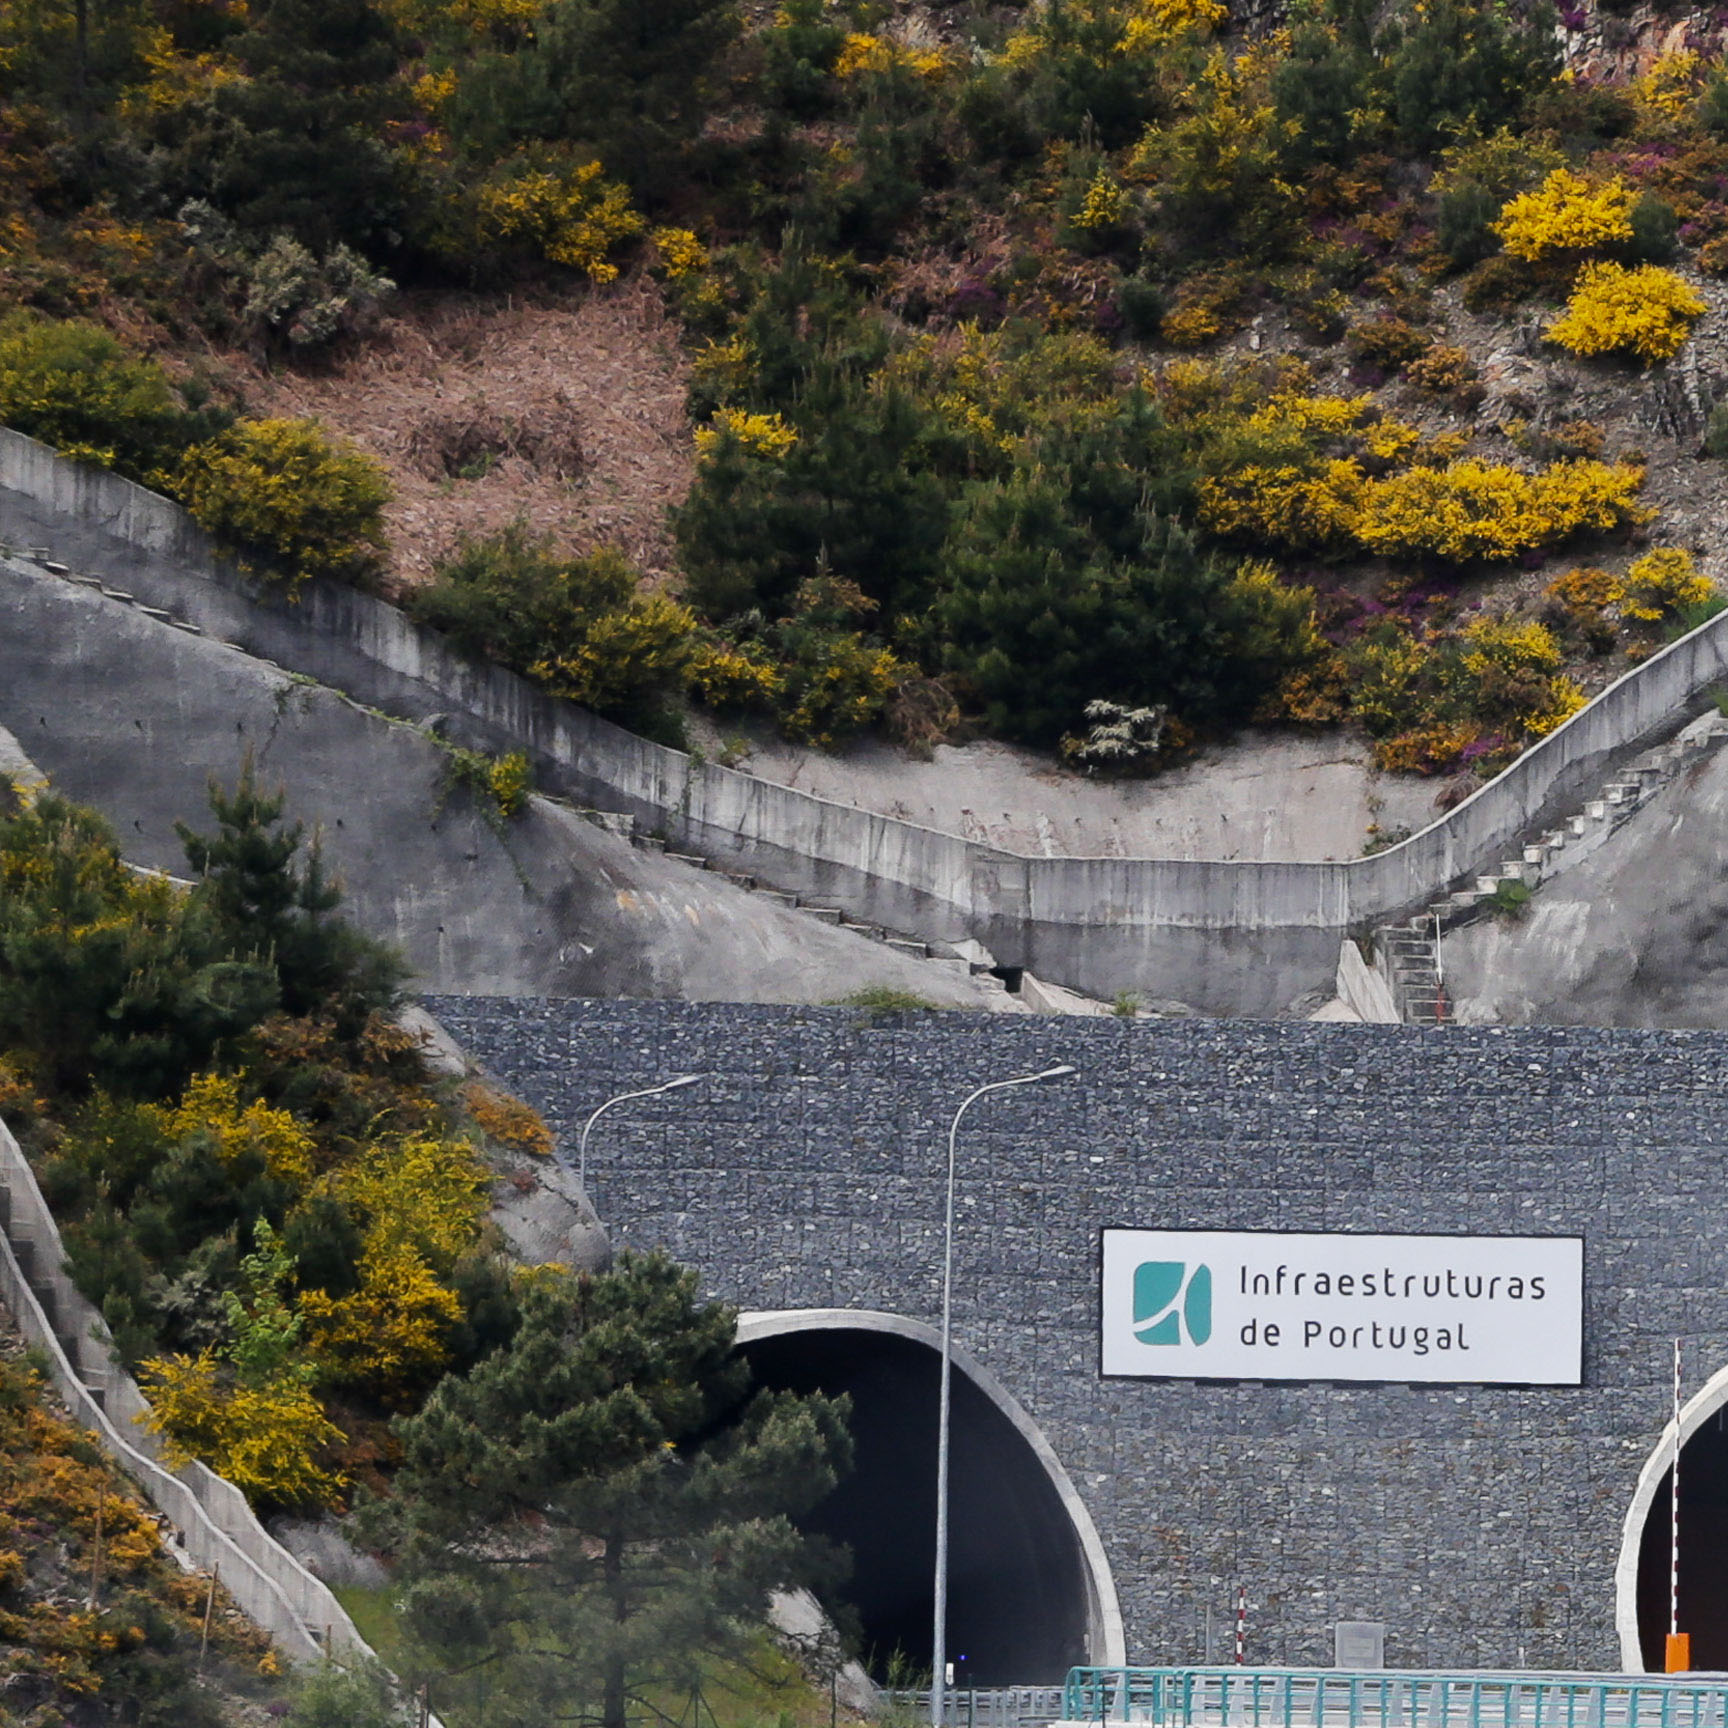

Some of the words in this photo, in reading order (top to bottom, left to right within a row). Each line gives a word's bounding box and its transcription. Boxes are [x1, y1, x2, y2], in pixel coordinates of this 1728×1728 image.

[1240, 1264, 1546, 1300] Infraestruturas
[1240, 1318, 1281, 1347] de
[1304, 1320, 1470, 1356] Portugal
